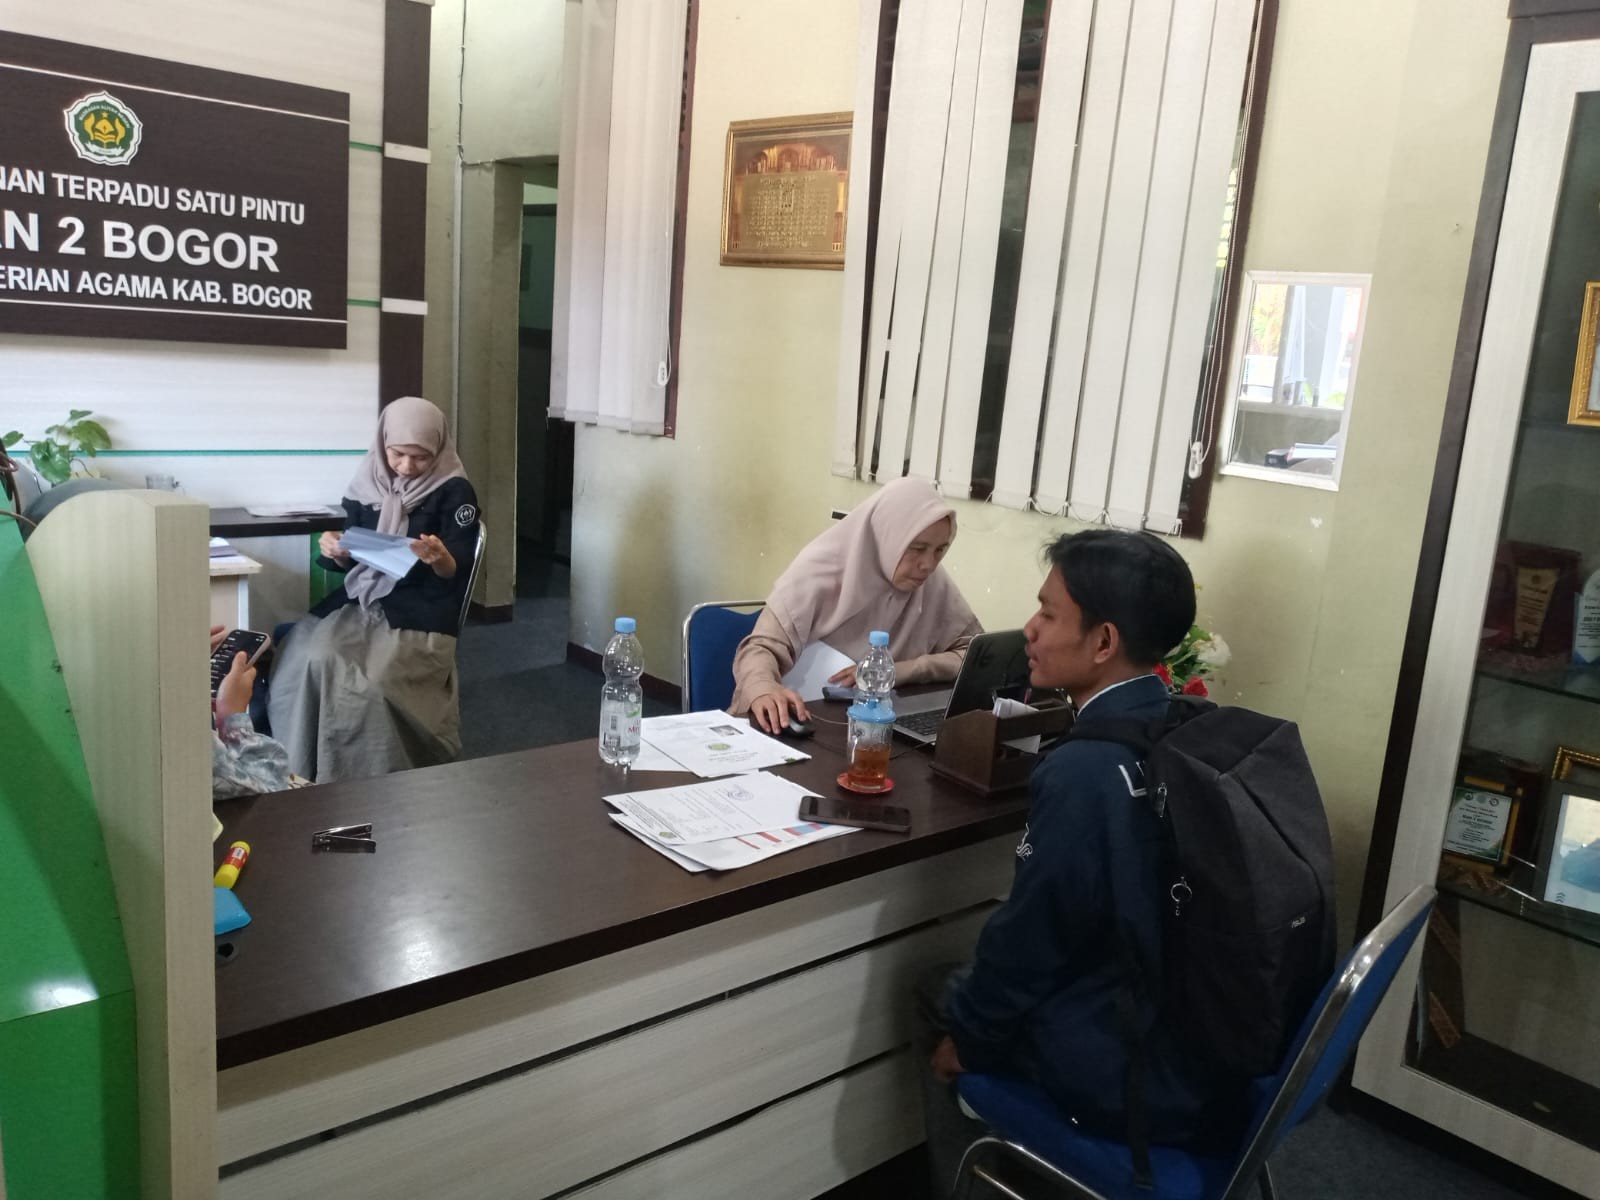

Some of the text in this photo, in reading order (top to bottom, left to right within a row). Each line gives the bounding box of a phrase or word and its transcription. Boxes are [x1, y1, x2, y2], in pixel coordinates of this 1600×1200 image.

[51, 172, 170, 210] TERPADU
[176, 188, 235, 217] SATU
[241, 195, 305, 225] PINTU
[0, 209, 280, 273] N 2 BOGOR
[76, 270, 168, 300] AGAMA
[172, 278, 228, 304] KAB.
[232, 282, 313, 311] BOGOR
